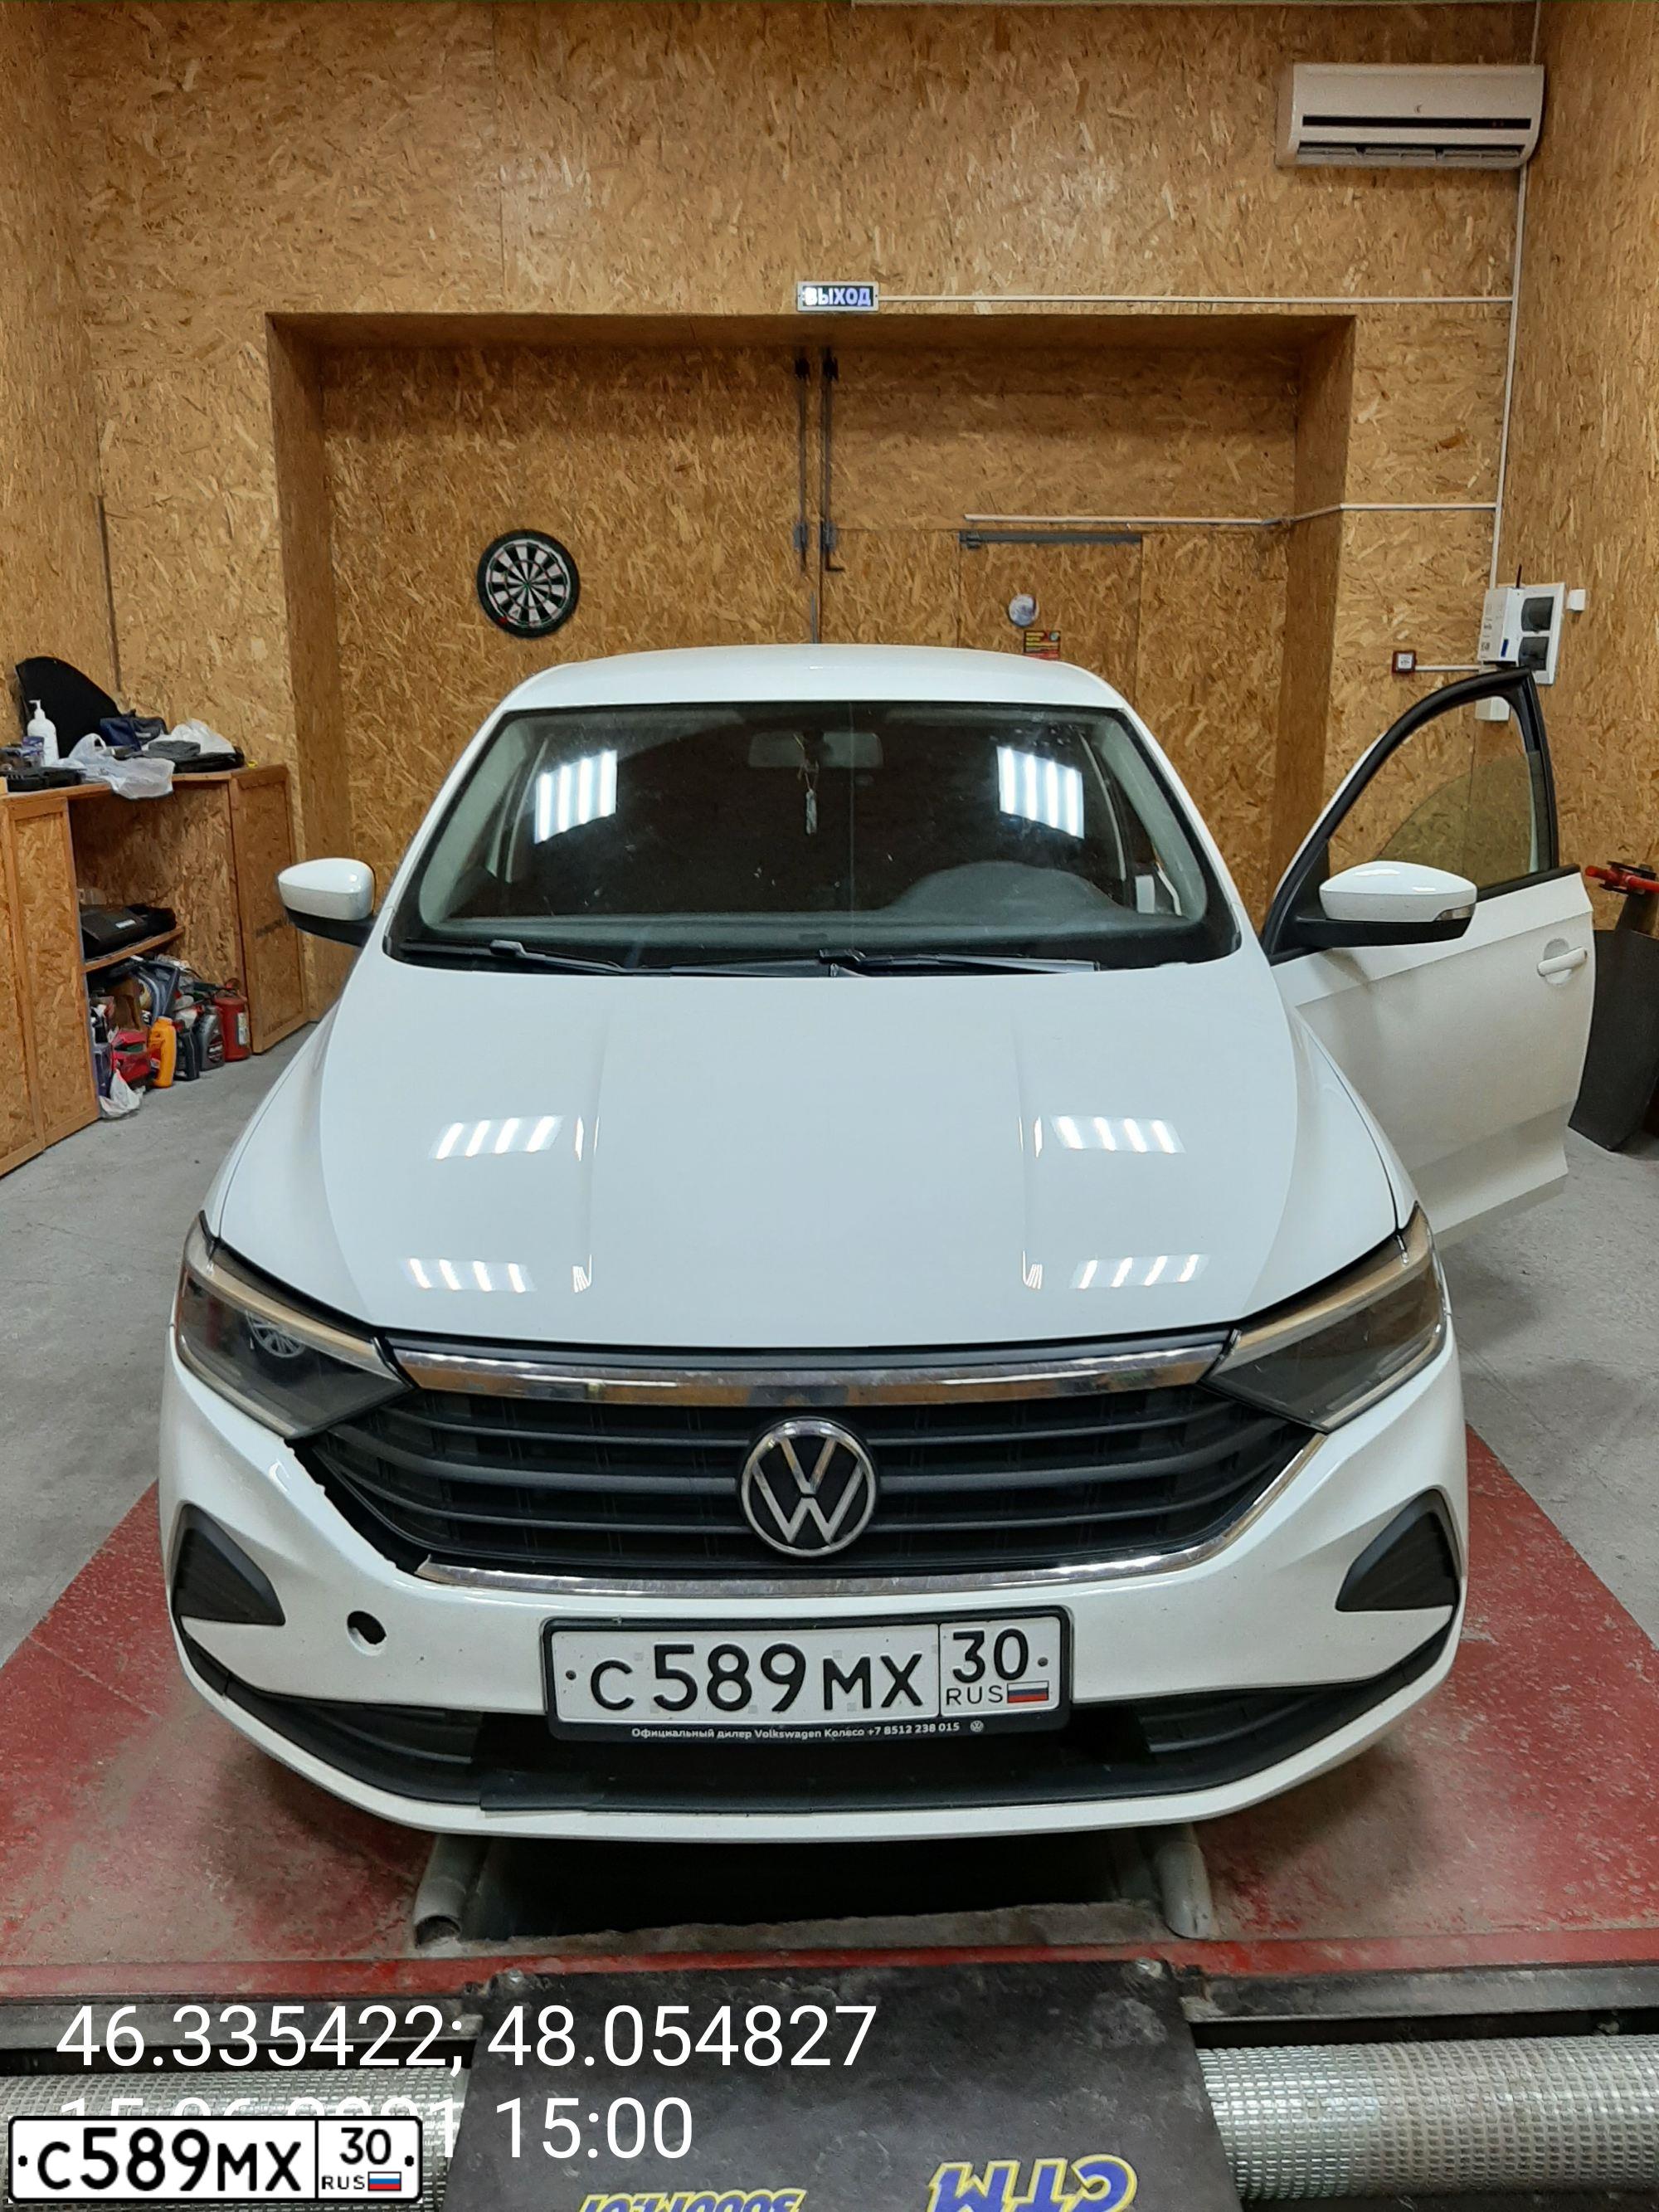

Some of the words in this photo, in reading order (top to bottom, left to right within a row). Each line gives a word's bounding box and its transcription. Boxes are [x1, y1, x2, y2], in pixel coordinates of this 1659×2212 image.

[952, 1628, 1029, 1683] 30
[946, 1685, 1003, 1706] RUS
[631, 1727, 714, 1739] Официальный
[717, 1730, 752, 1740] дилер
[754, 1728, 822, 1740] Volkswagen
[868, 1726, 881, 1736] +7
[883, 1725, 912, 1735] 8512
[914, 1723, 937, 1733] 238
[938, 1722, 960, 1732] 015
